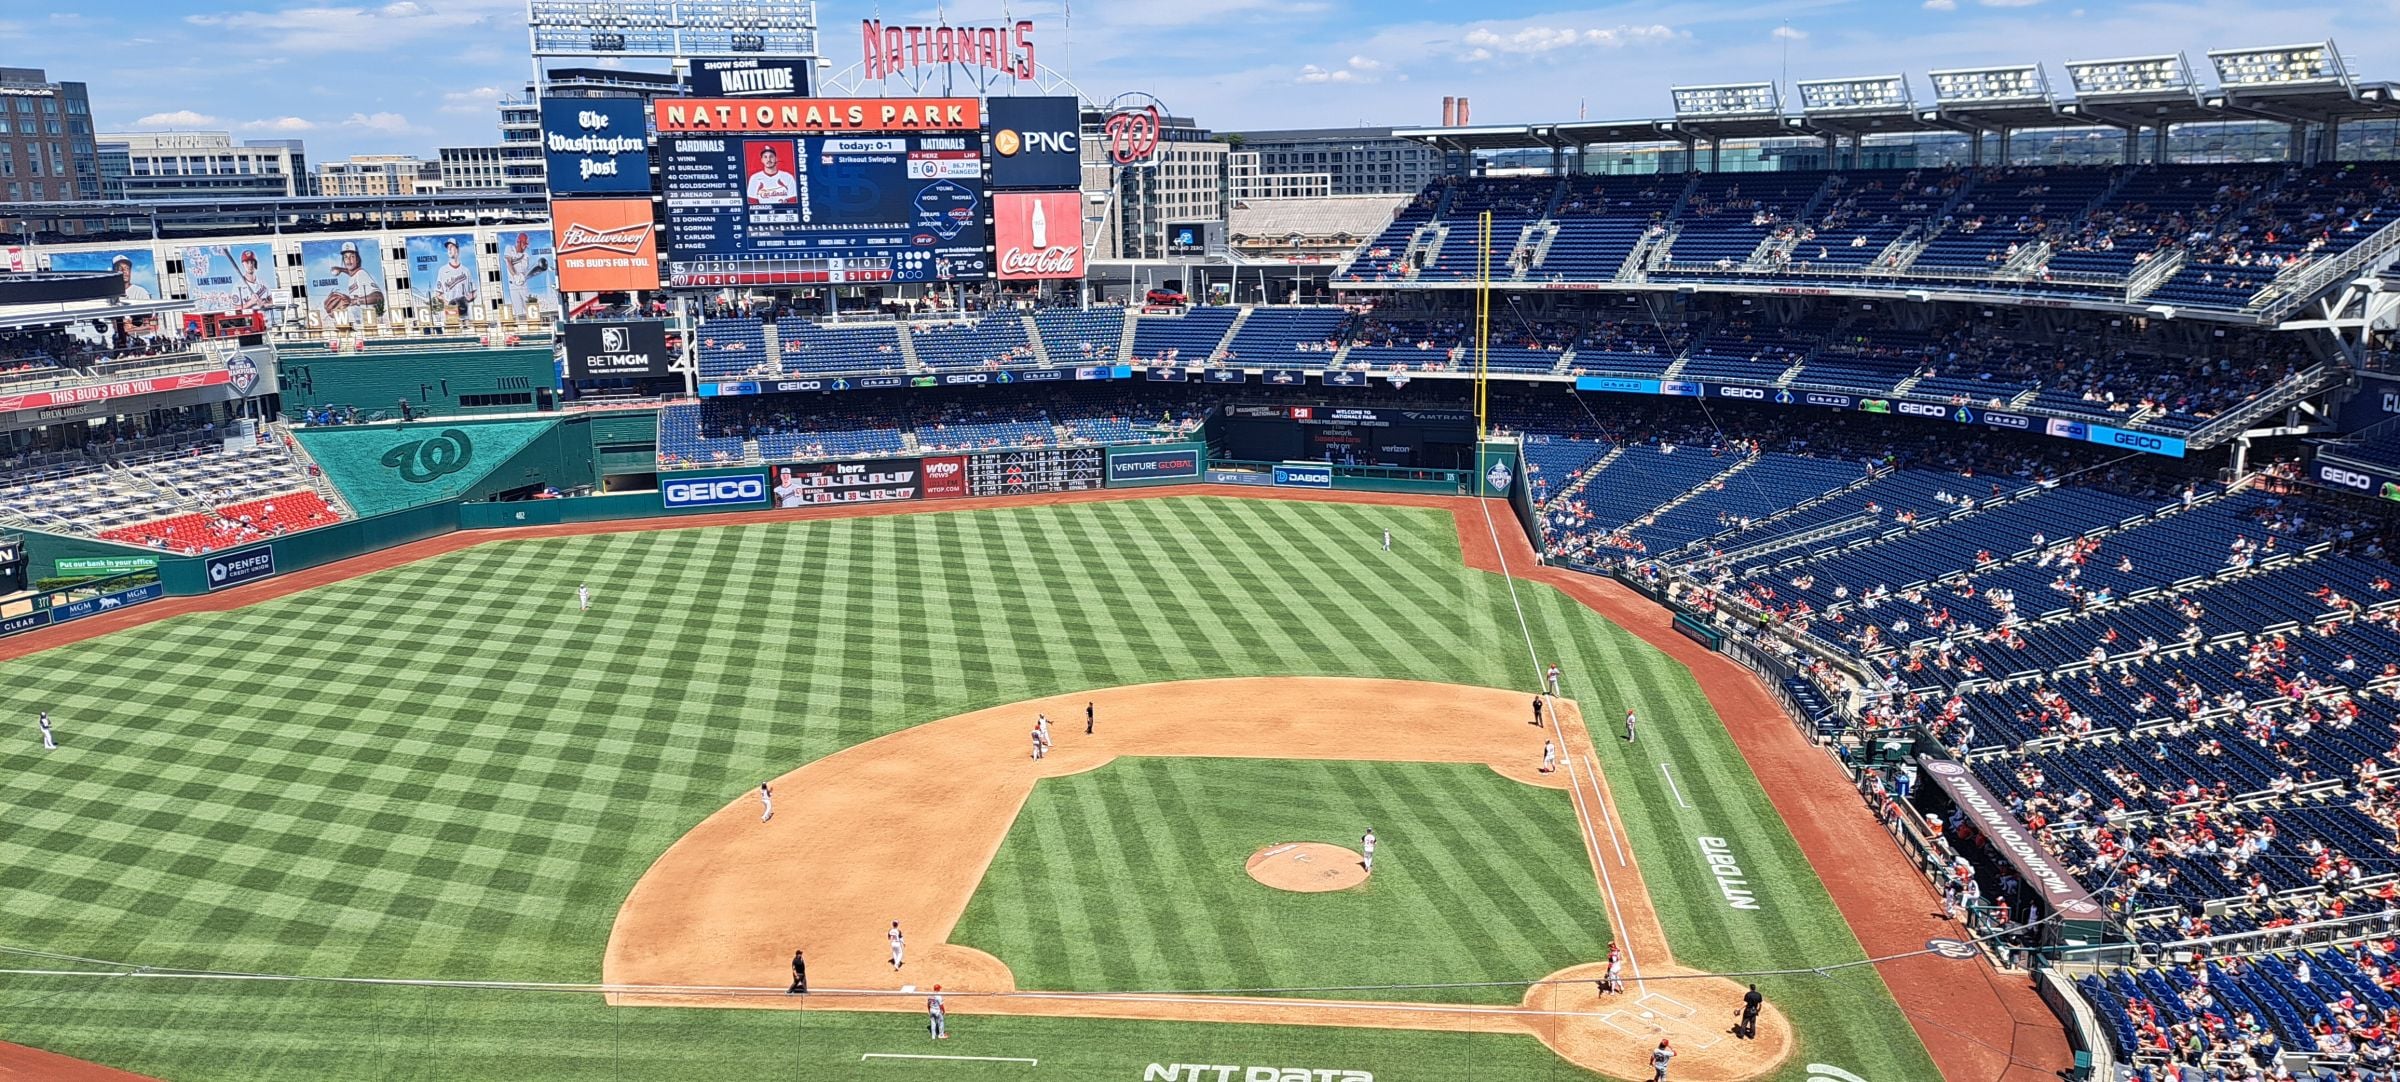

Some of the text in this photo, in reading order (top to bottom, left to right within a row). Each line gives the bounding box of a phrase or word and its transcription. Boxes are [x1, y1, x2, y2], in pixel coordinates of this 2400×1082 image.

[863, 19, 1035, 80] NATIONALS
[704, 61, 758, 70] SHOW SOME
[721, 68, 794, 91] NATITUDE
[579, 110, 609, 130] The
[668, 105, 962, 125] NATIONALS PARK
[548, 131, 644, 155] Washington
[675, 140, 725, 152] CARDINALS
[839, 142, 892, 151] today: 0-1
[921, 138, 965, 150] NATIONALS
[1022, 131, 1076, 152] PNC
[868, 156, 896, 164] Swinging
[580, 159, 618, 180] Post
[797, 139, 813, 222] nolan arenado
[564, 230, 642, 245] Budweiser
[586, 259, 612, 267] BUD'S
[613, 258, 629, 267] FOR
[631, 258, 650, 267] YOU.
[698, 262, 704, 271] 0
[713, 263, 720, 271] 2
[728, 263, 735, 271] 0
[1002, 246, 1078, 275] Coca-Cola
[197, 276, 232, 286] LANE THOMAS
[319, 279, 338, 287] ABRAMS
[699, 276, 706, 284] 0
[714, 276, 721, 284] 2
[729, 275, 736, 283] 0
[587, 354, 648, 366] BETMGM
[946, 374, 987, 383] GEICO
[778, 381, 820, 391] GEICO
[1667, 384, 1694, 392] GEICO
[49, 381, 156, 404] THIS BUD'S FOR YOU.
[1721, 387, 1764, 399] GEICO
[40, 406, 88, 420] BREW HOUSE
[1899, 402, 1946, 417] GEICO
[2055, 423, 2082, 435] GEICO
[2114, 432, 2162, 450] GEICO
[837, 463, 865, 473] herz
[926, 462, 958, 474] wtop
[1116, 460, 1193, 472] VENTURE GLOBAL
[1289, 473, 1329, 483] DABOS
[2321, 466, 2371, 490] GEICO
[667, 480, 762, 502] GEICO
[227, 555, 269, 572] PENFED
[229, 564, 269, 577] CREDIT UNION
[126, 588, 147, 600] MGM
[69, 602, 92, 613] MGM
[4, 617, 35, 630] CLEAR
[1948, 776, 2073, 894] WASHINGTON NATIONALS
[1716, 876, 1760, 910] NTT
[1143, 1062, 1240, 1082] NTT
